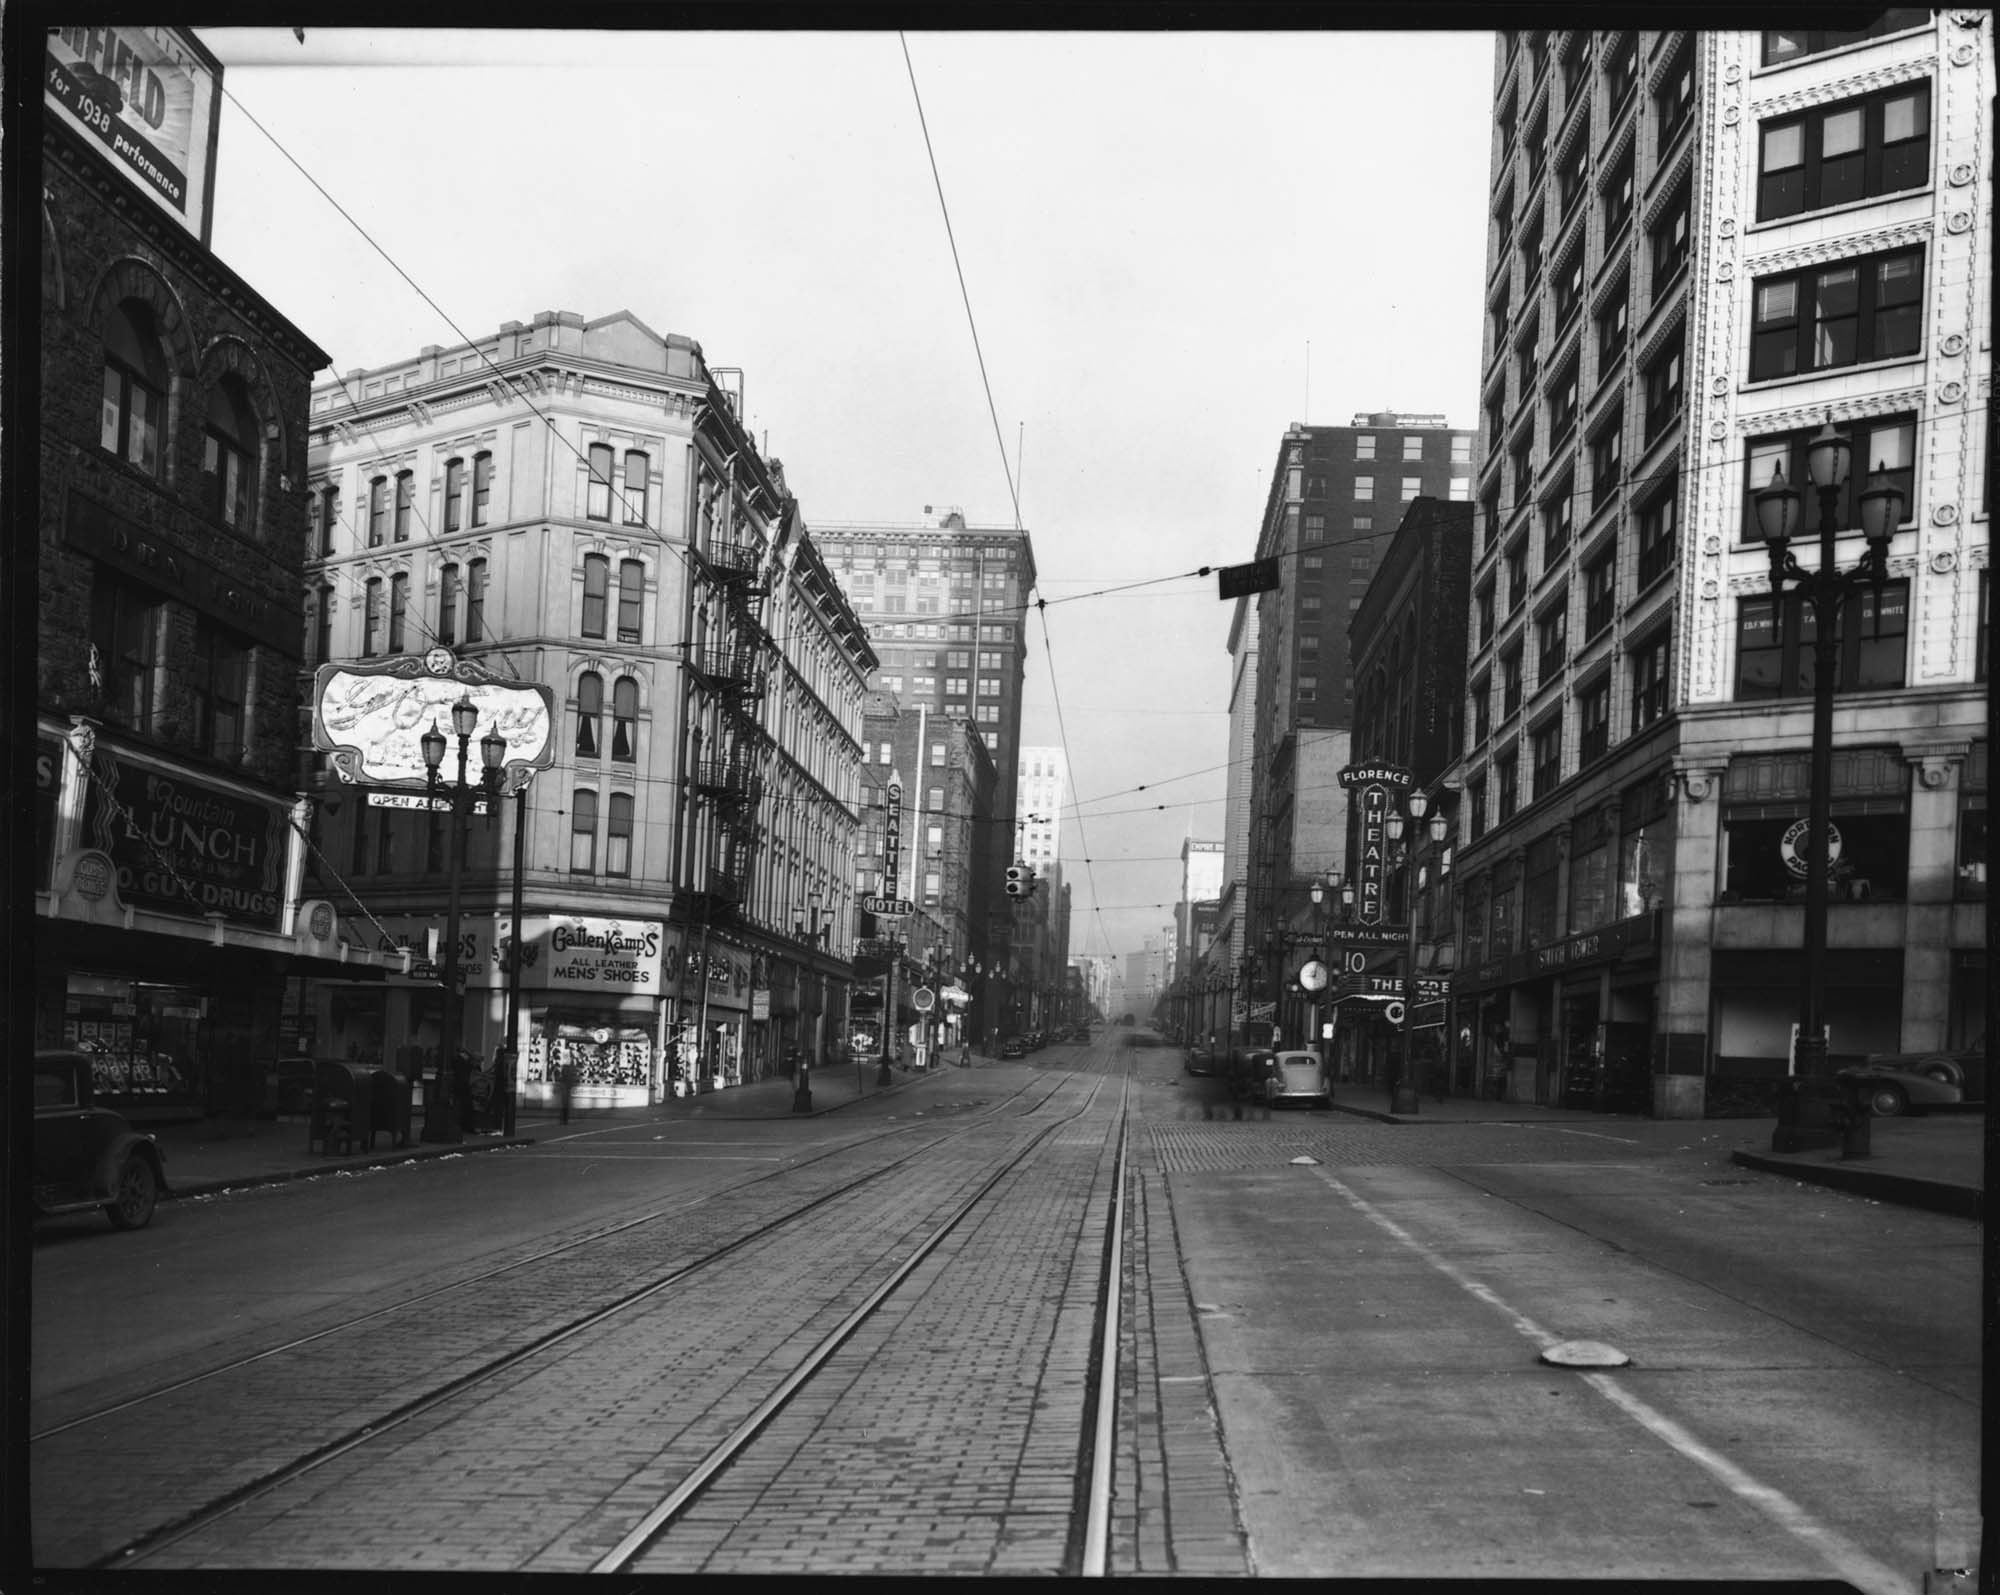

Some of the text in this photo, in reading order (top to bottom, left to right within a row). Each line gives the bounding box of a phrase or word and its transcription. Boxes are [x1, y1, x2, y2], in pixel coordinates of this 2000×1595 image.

[48, 68, 181, 199] for 1938 performance
[1343, 769, 1410, 785] FLORENCE
[372, 795, 410, 807] OPEN
[125, 805, 258, 867] LUNCH
[886, 784, 901, 893] SEATTLE
[1363, 790, 1383, 915] THEATRE
[202, 883, 279, 917] DRUGS
[866, 898, 912, 914] HOTEL
[1326, 930, 1355, 939] PEN
[1358, 931, 1379, 940] ALL
[571, 957, 639, 969] ALL LEATHER
[603, 969, 649, 983] SHOES
